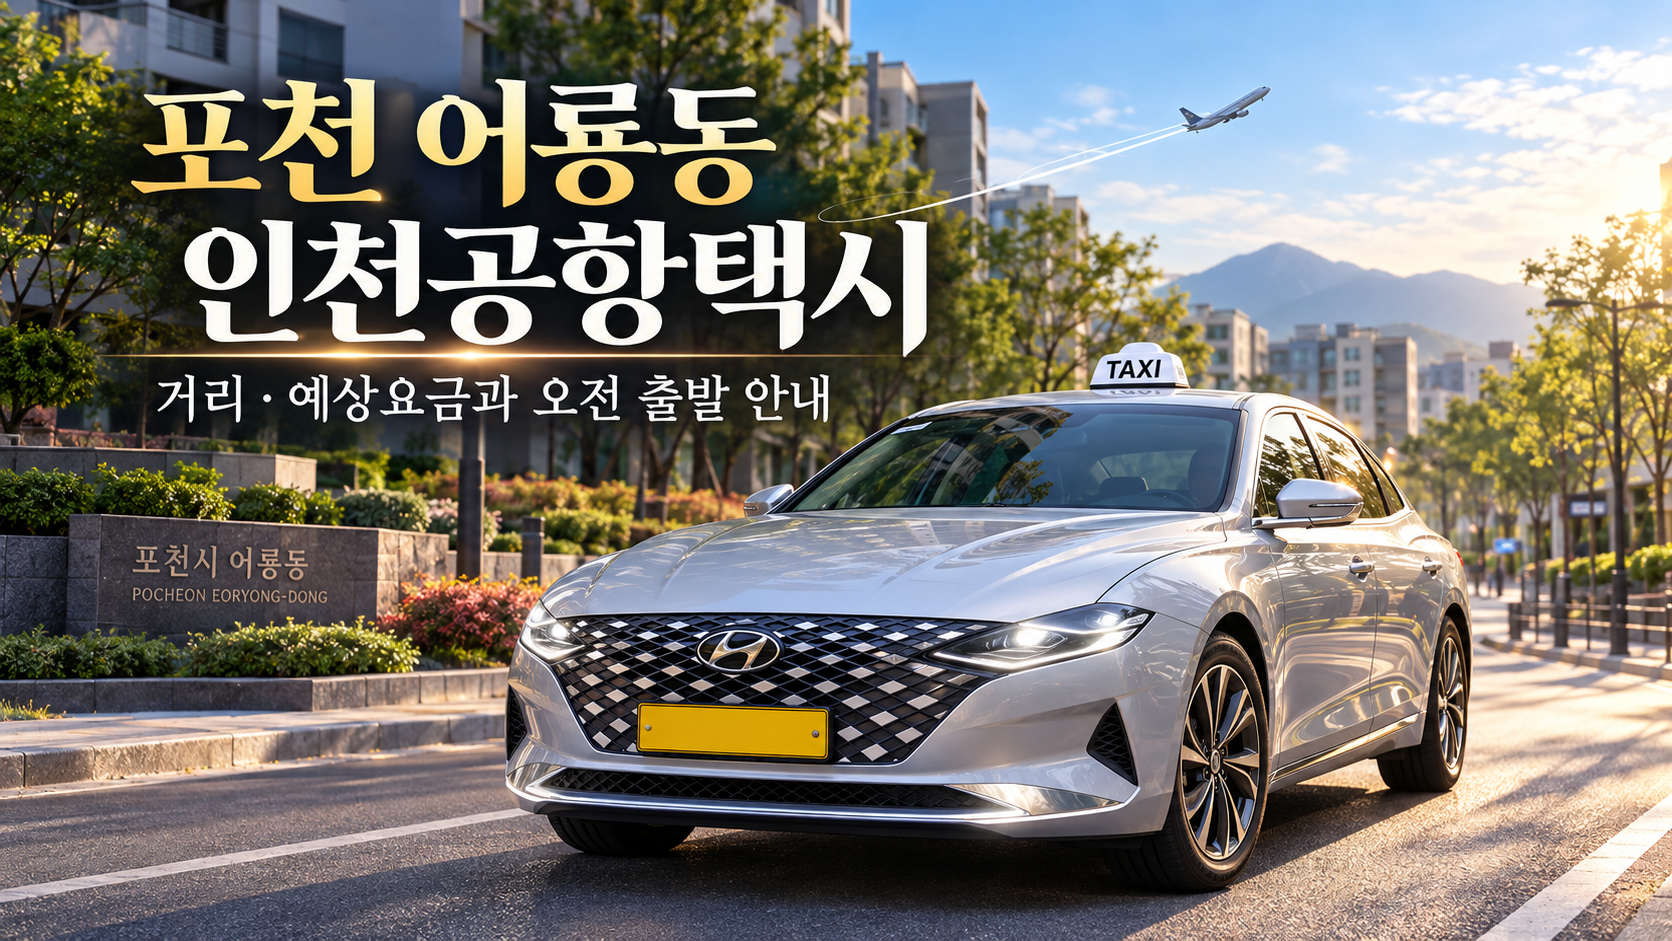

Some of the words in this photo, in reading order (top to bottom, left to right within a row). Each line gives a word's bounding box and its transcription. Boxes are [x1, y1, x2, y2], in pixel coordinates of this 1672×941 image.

[1106, 359, 1161, 379] TAXI
[132, 544, 218, 579] 포천시
[229, 546, 309, 581] 어룡동
[132, 587, 206, 602] POCHEON
[212, 588, 328, 604] EORYONG-DONG
